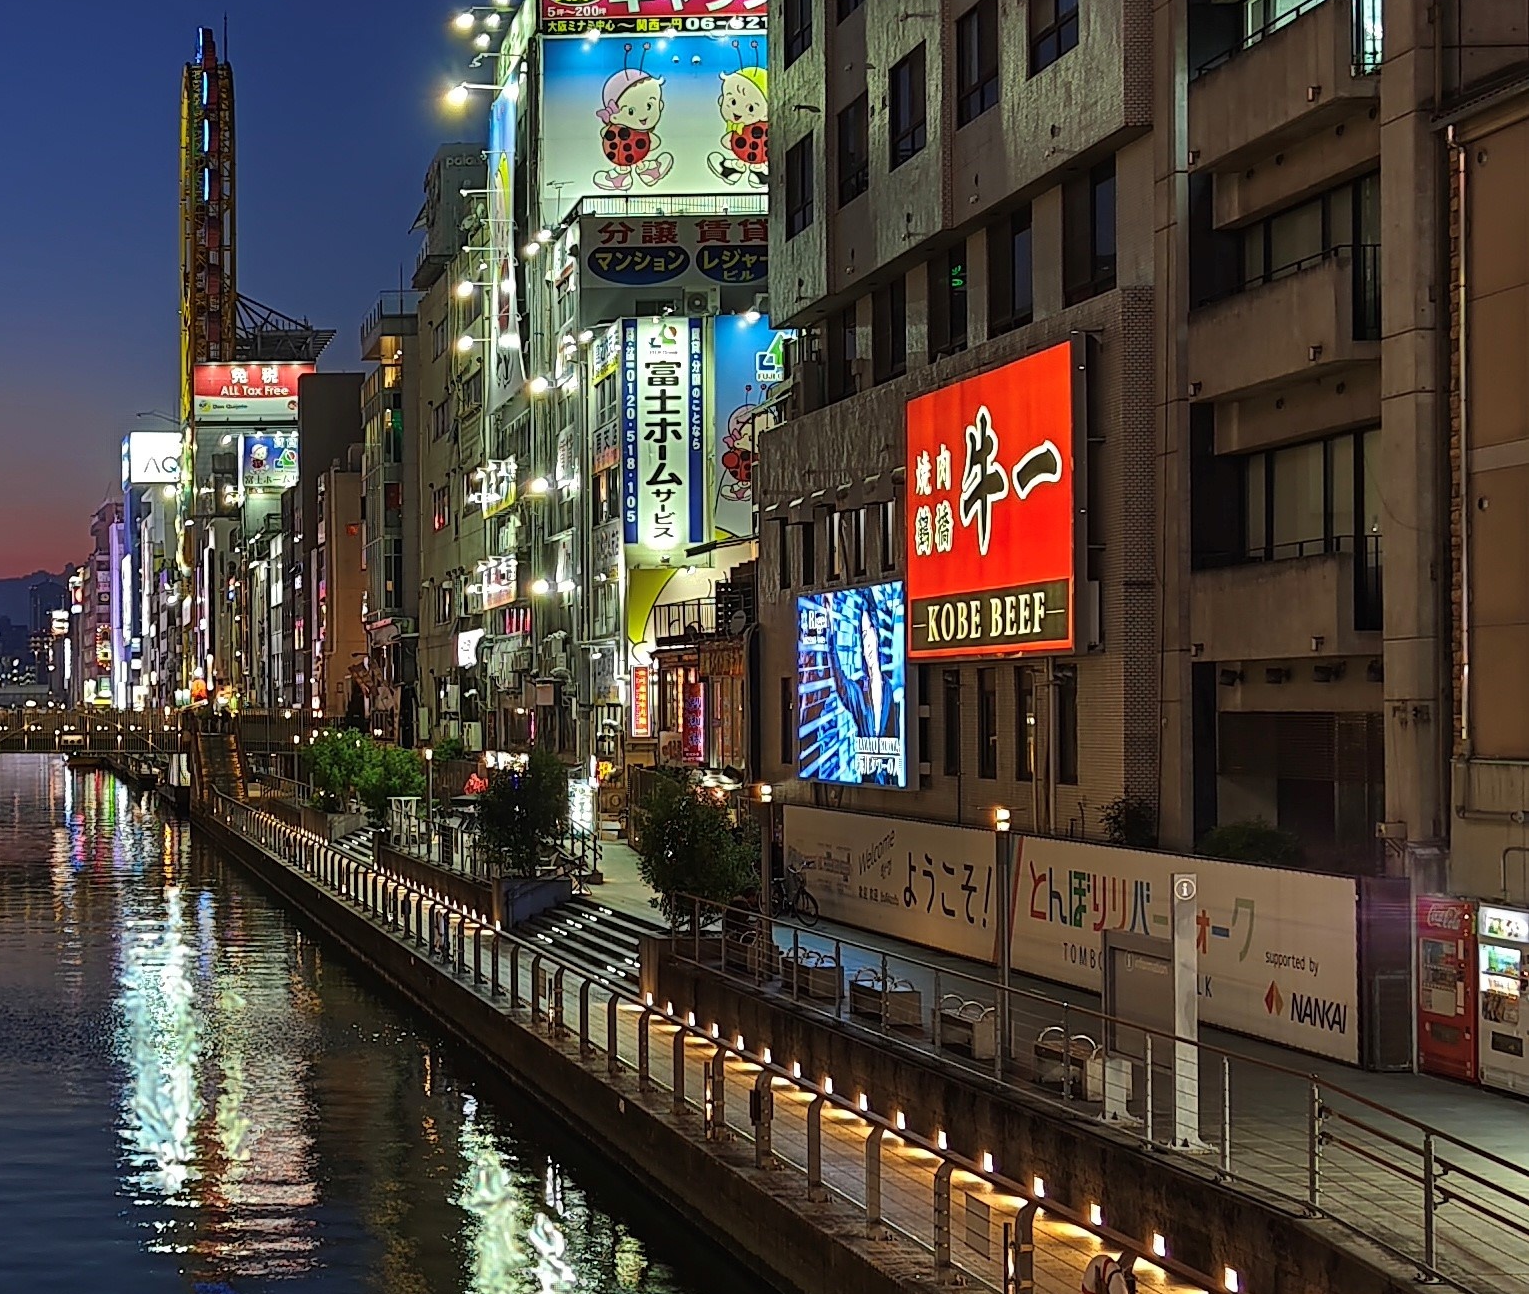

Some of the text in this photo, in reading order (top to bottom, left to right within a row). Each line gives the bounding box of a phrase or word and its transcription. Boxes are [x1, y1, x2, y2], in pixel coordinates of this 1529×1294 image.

[597, 221, 679, 245] 分譲
[595, 251, 685, 272] マンション
[723, 270, 754, 281] ビル
[220, 386, 289, 396] ALL Tax Free
[644, 360, 683, 539] 富士ホームサービス
[927, 591, 1046, 642] KOBE BEEF
[859, 830, 895, 876] Welcome
[1265, 951, 1319, 975] supported by
[1290, 992, 1347, 1034] NANKAI
